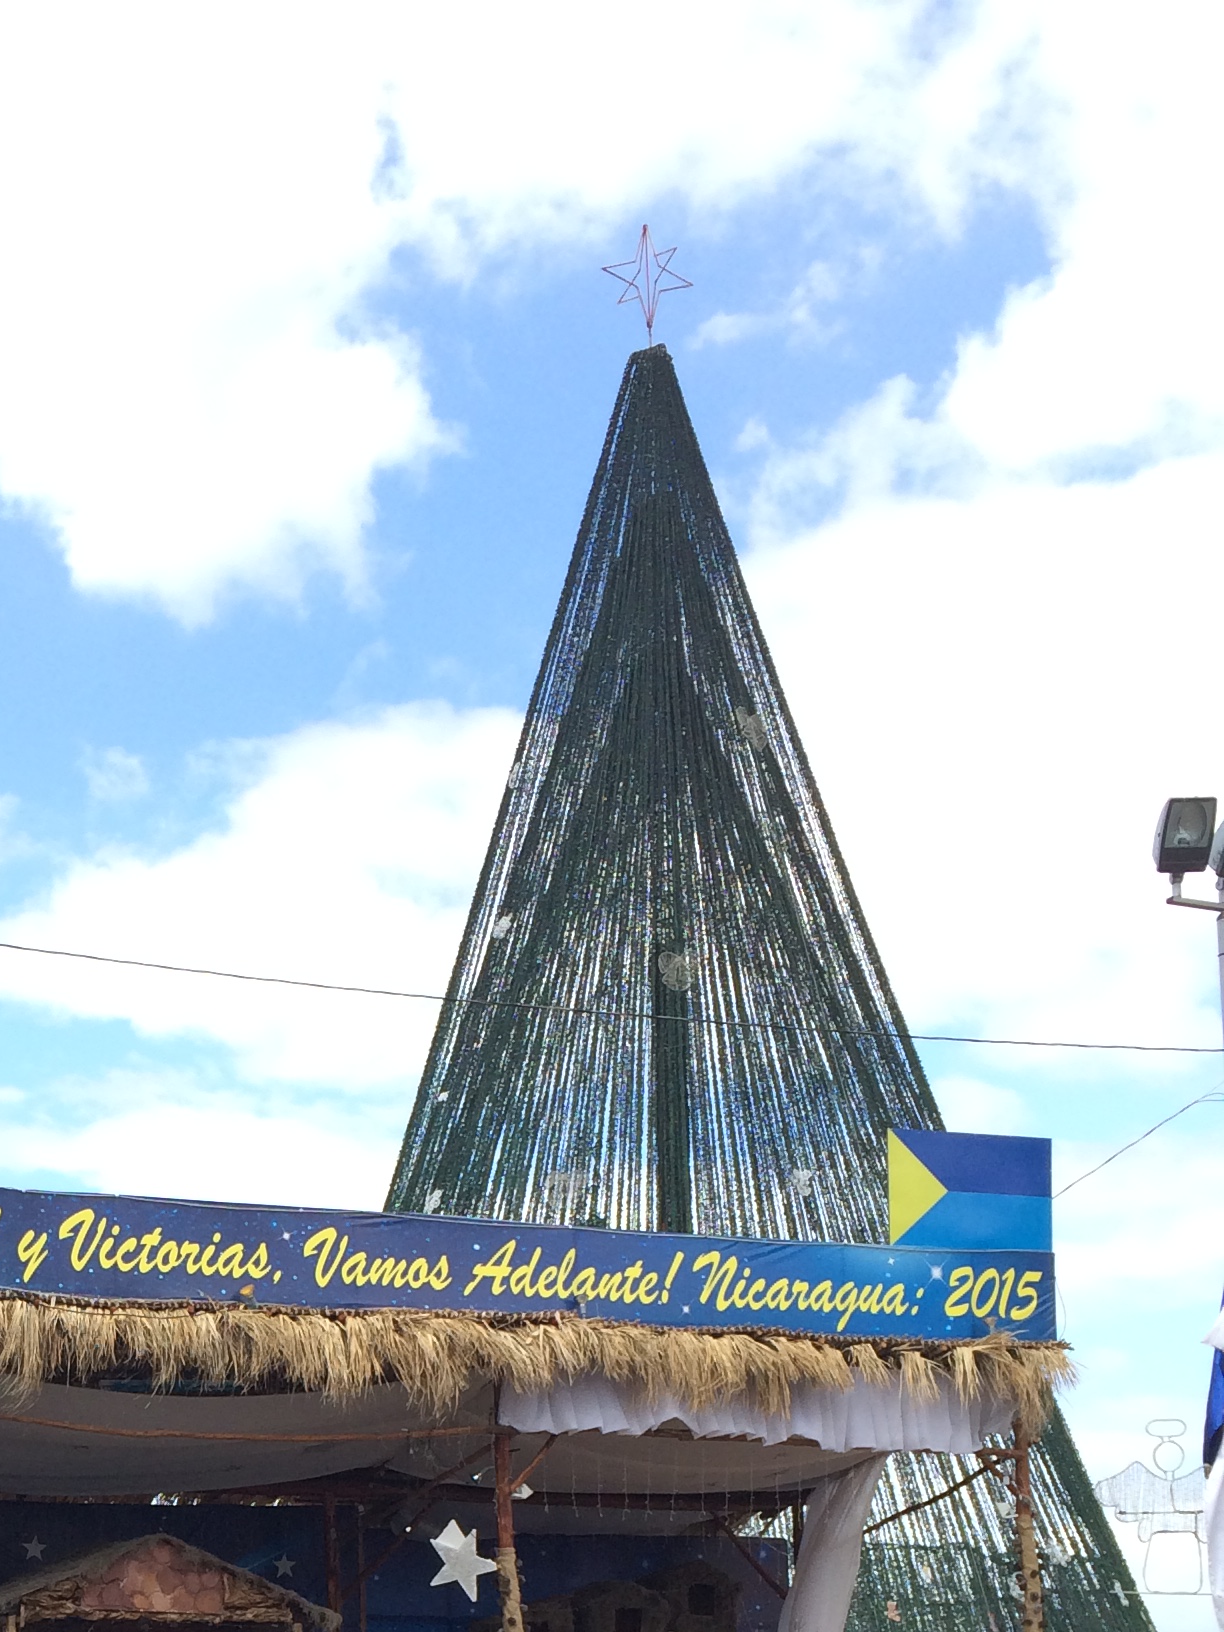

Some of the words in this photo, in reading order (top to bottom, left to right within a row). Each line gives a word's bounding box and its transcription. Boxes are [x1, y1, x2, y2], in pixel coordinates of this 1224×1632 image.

[16, 1229, 48, 1283] y
[57, 1208, 282, 1284] Victorias,
[302, 1226, 452, 1292] Vamos
[463, 1239, 684, 1305] Adelante!
[691, 1250, 926, 1331] Nicaragua:
[943, 1265, 1044, 1322] 2015
